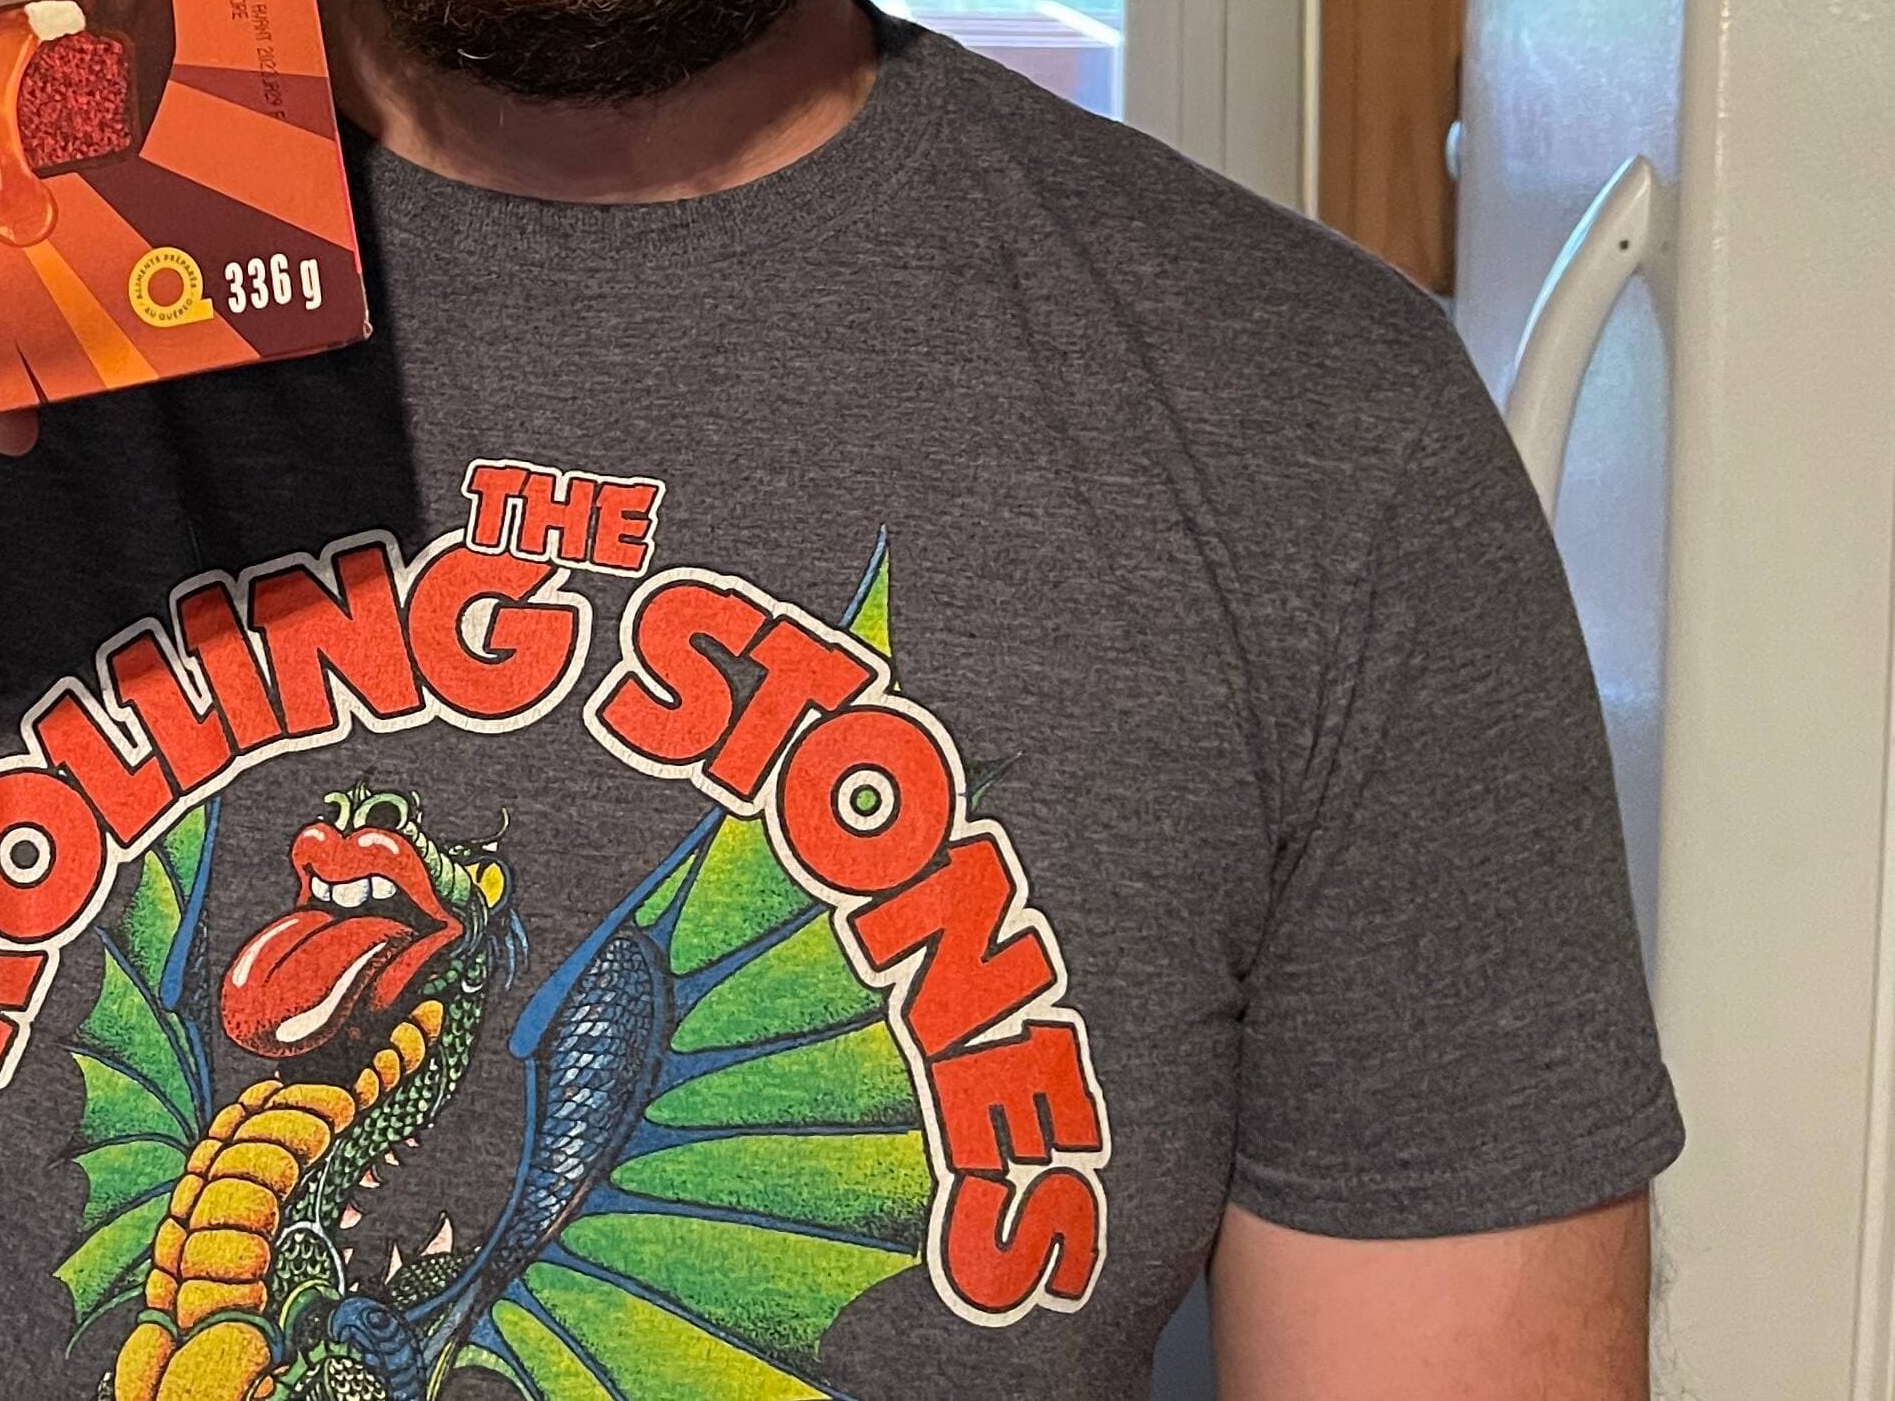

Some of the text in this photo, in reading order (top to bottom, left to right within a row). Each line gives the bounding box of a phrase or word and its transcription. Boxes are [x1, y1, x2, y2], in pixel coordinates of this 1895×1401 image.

[225, 253, 322, 313] 336 g
[468, 462, 662, 571] THE
[590, 572, 1107, 1321] STONES
